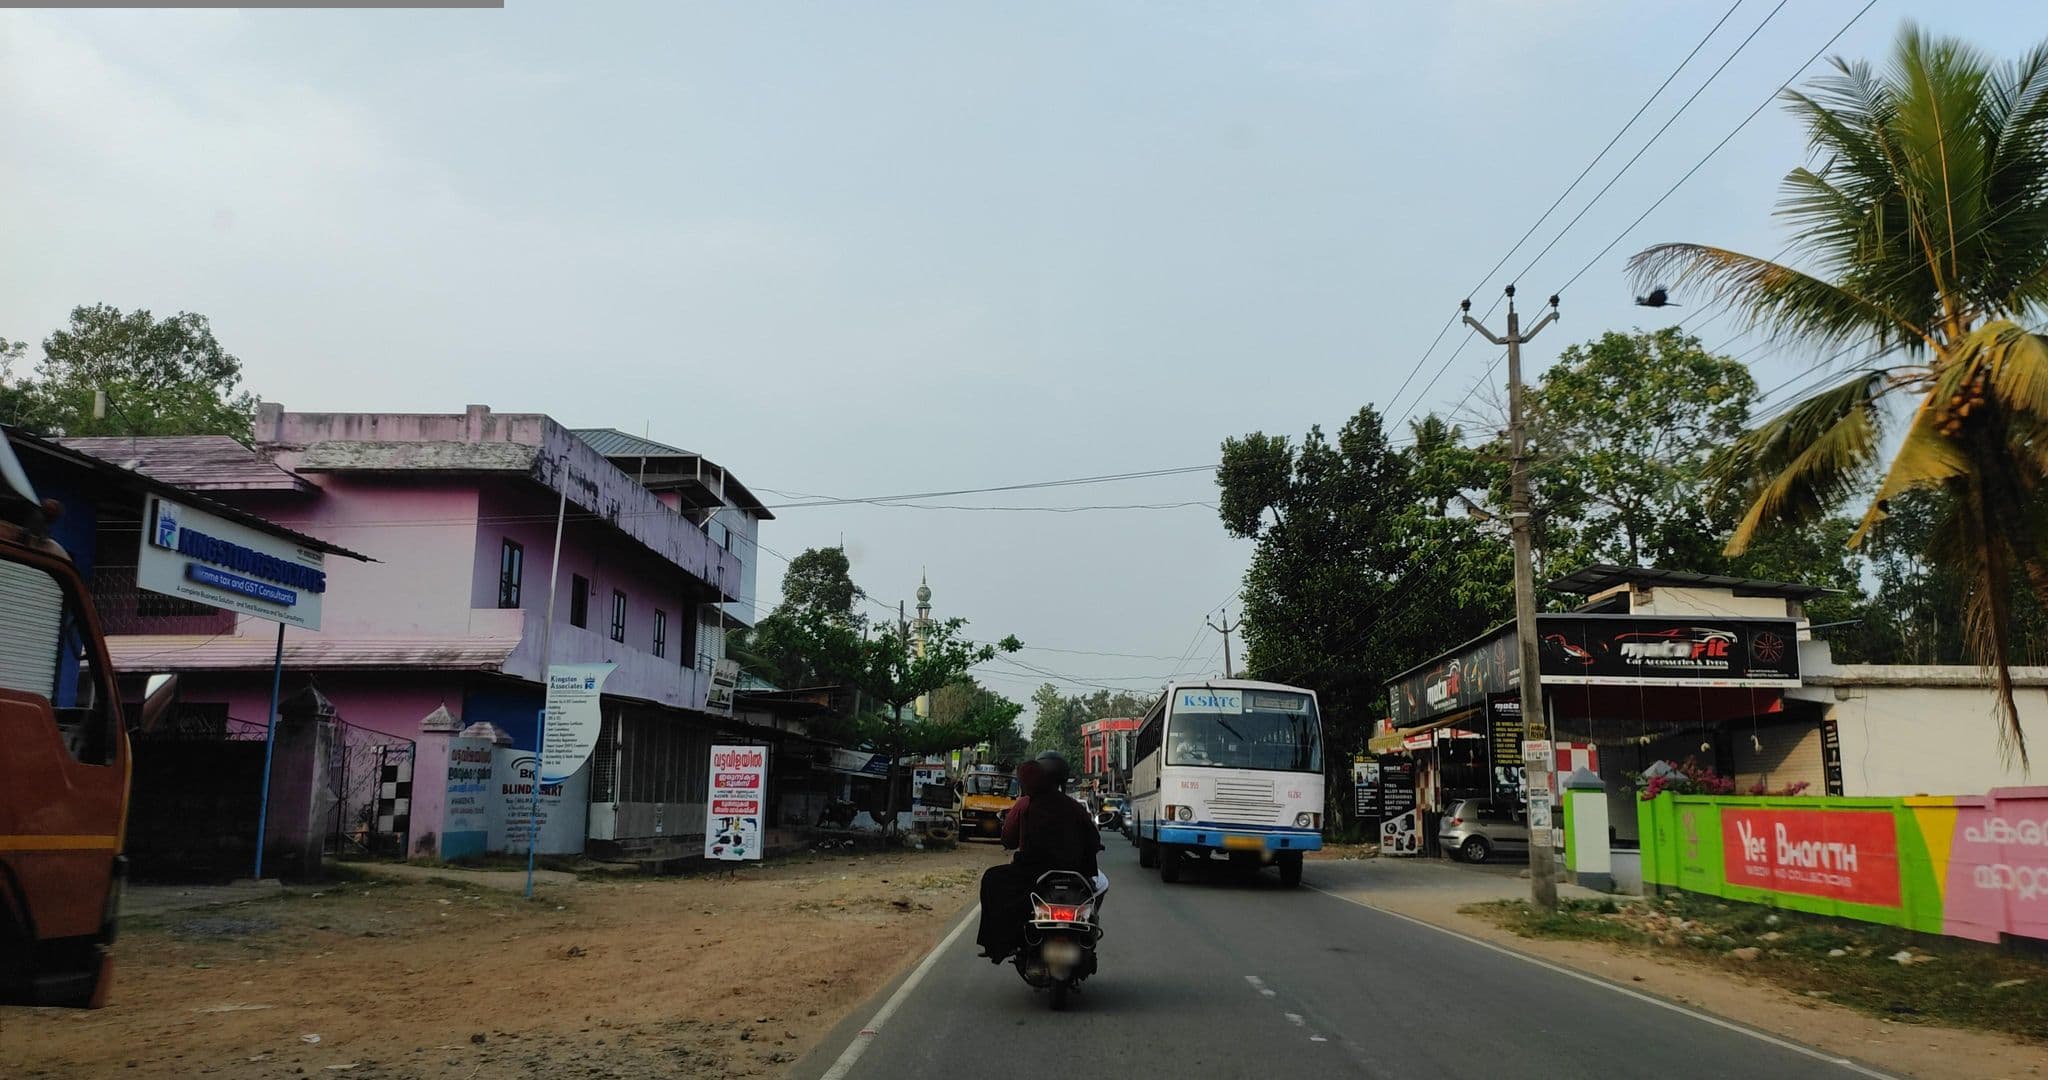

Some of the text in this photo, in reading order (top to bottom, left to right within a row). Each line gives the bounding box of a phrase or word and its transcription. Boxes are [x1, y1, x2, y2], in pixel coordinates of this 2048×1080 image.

[244, 581, 259, 593] GST
[551, 675, 577, 684] Kingston
[1184, 695, 1241, 708] KSRTC
